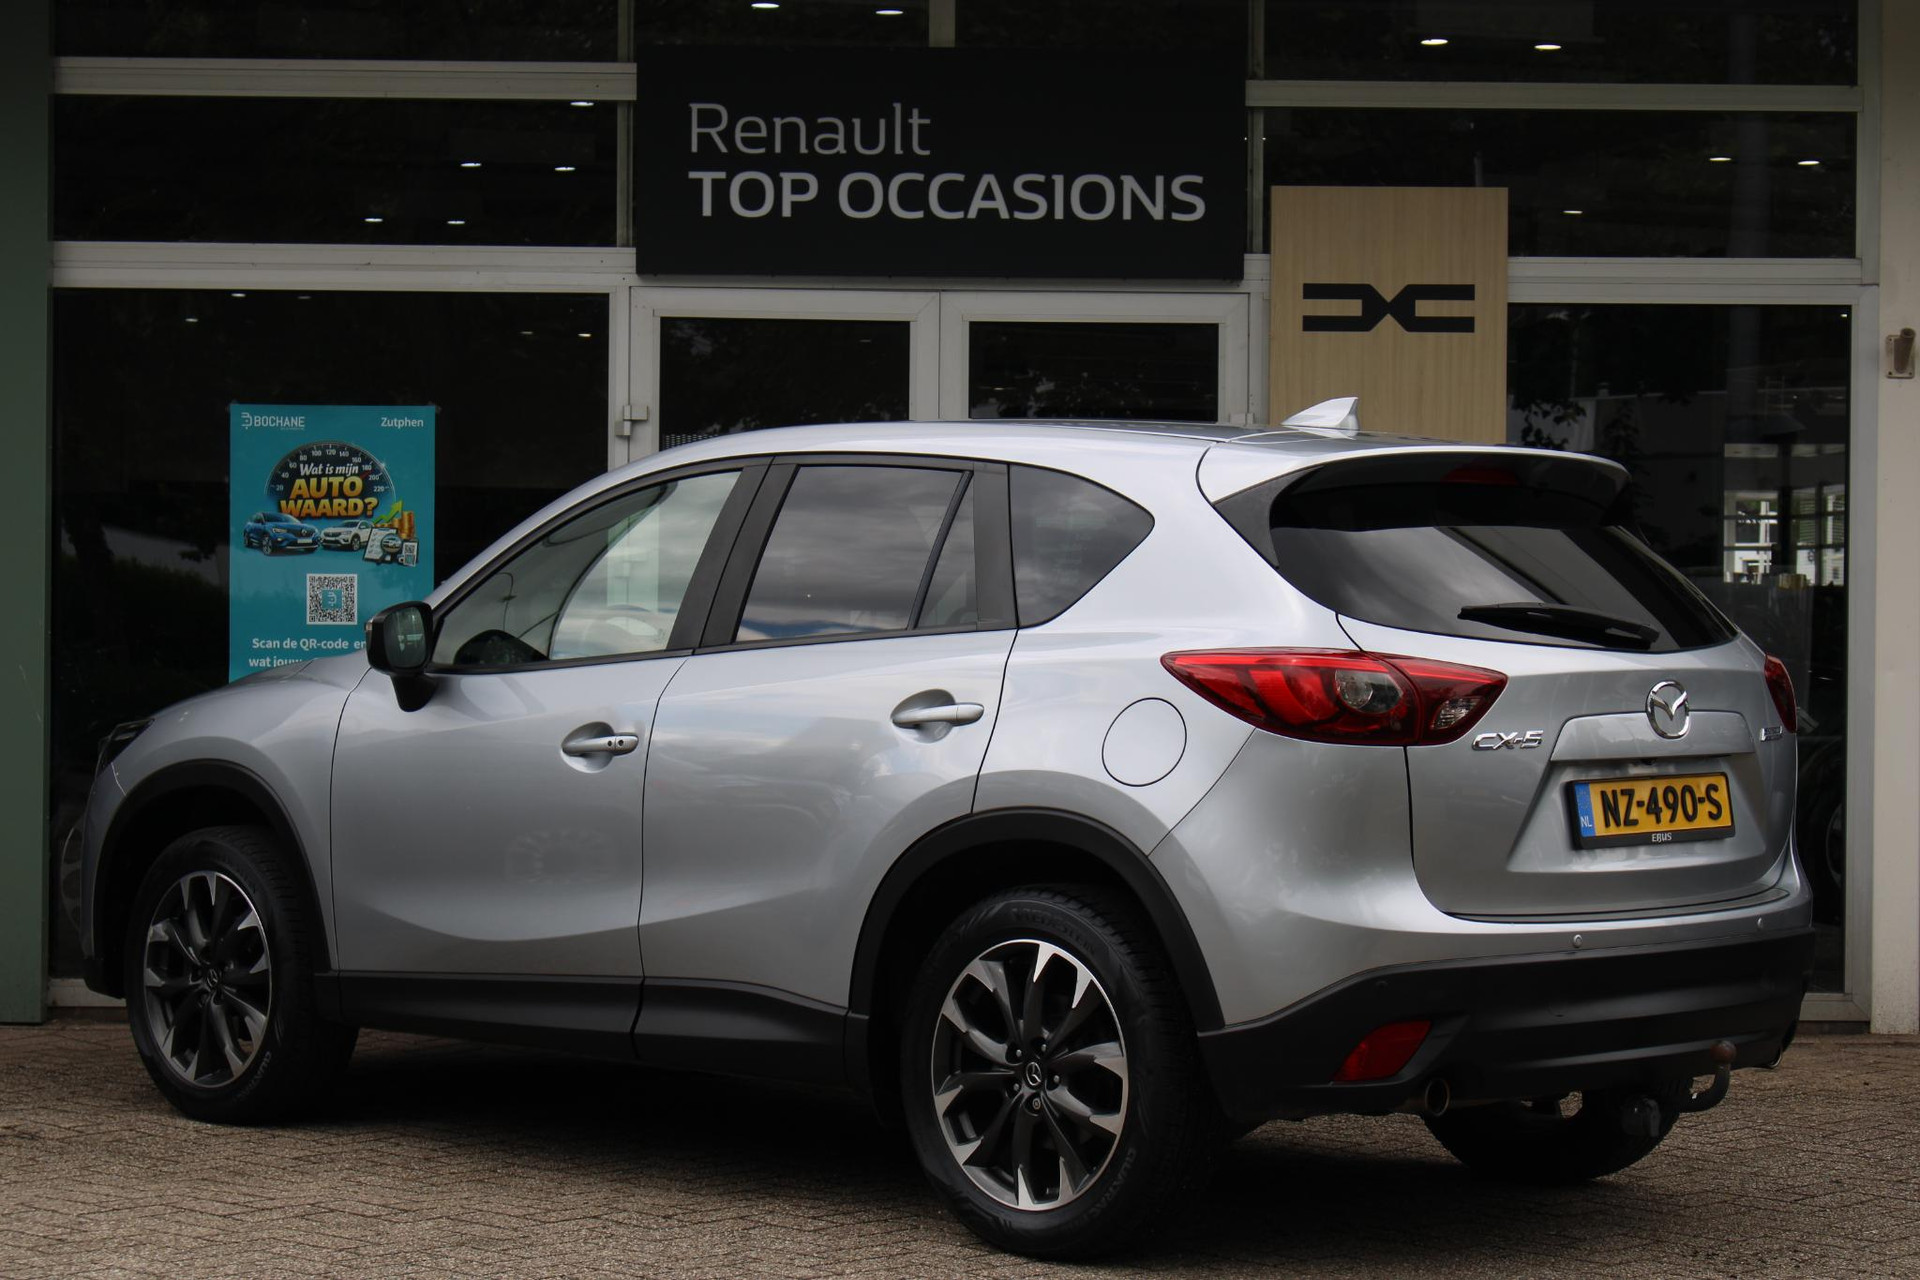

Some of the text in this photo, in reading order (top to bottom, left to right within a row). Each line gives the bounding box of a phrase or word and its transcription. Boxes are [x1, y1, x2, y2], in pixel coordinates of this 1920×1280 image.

[688, 102, 931, 155] Renault
[688, 170, 1206, 221] TOP OCCASIONS
[254, 415, 305, 427] BOCHANE
[381, 416, 424, 429] Zutphen
[300, 462, 359, 477] Wat is mijn
[289, 475, 363, 500] AUTO
[280, 497, 379, 518] WAARD?
[252, 638, 280, 649] Scan
[283, 637, 297, 649] de
[300, 638, 349, 651] QR-code
[249, 656, 271, 667] wat
[1472, 730, 1544, 750] CX-5
[1600, 783, 1722, 828] NZ-490-S
[1580, 815, 1592, 828] NL
